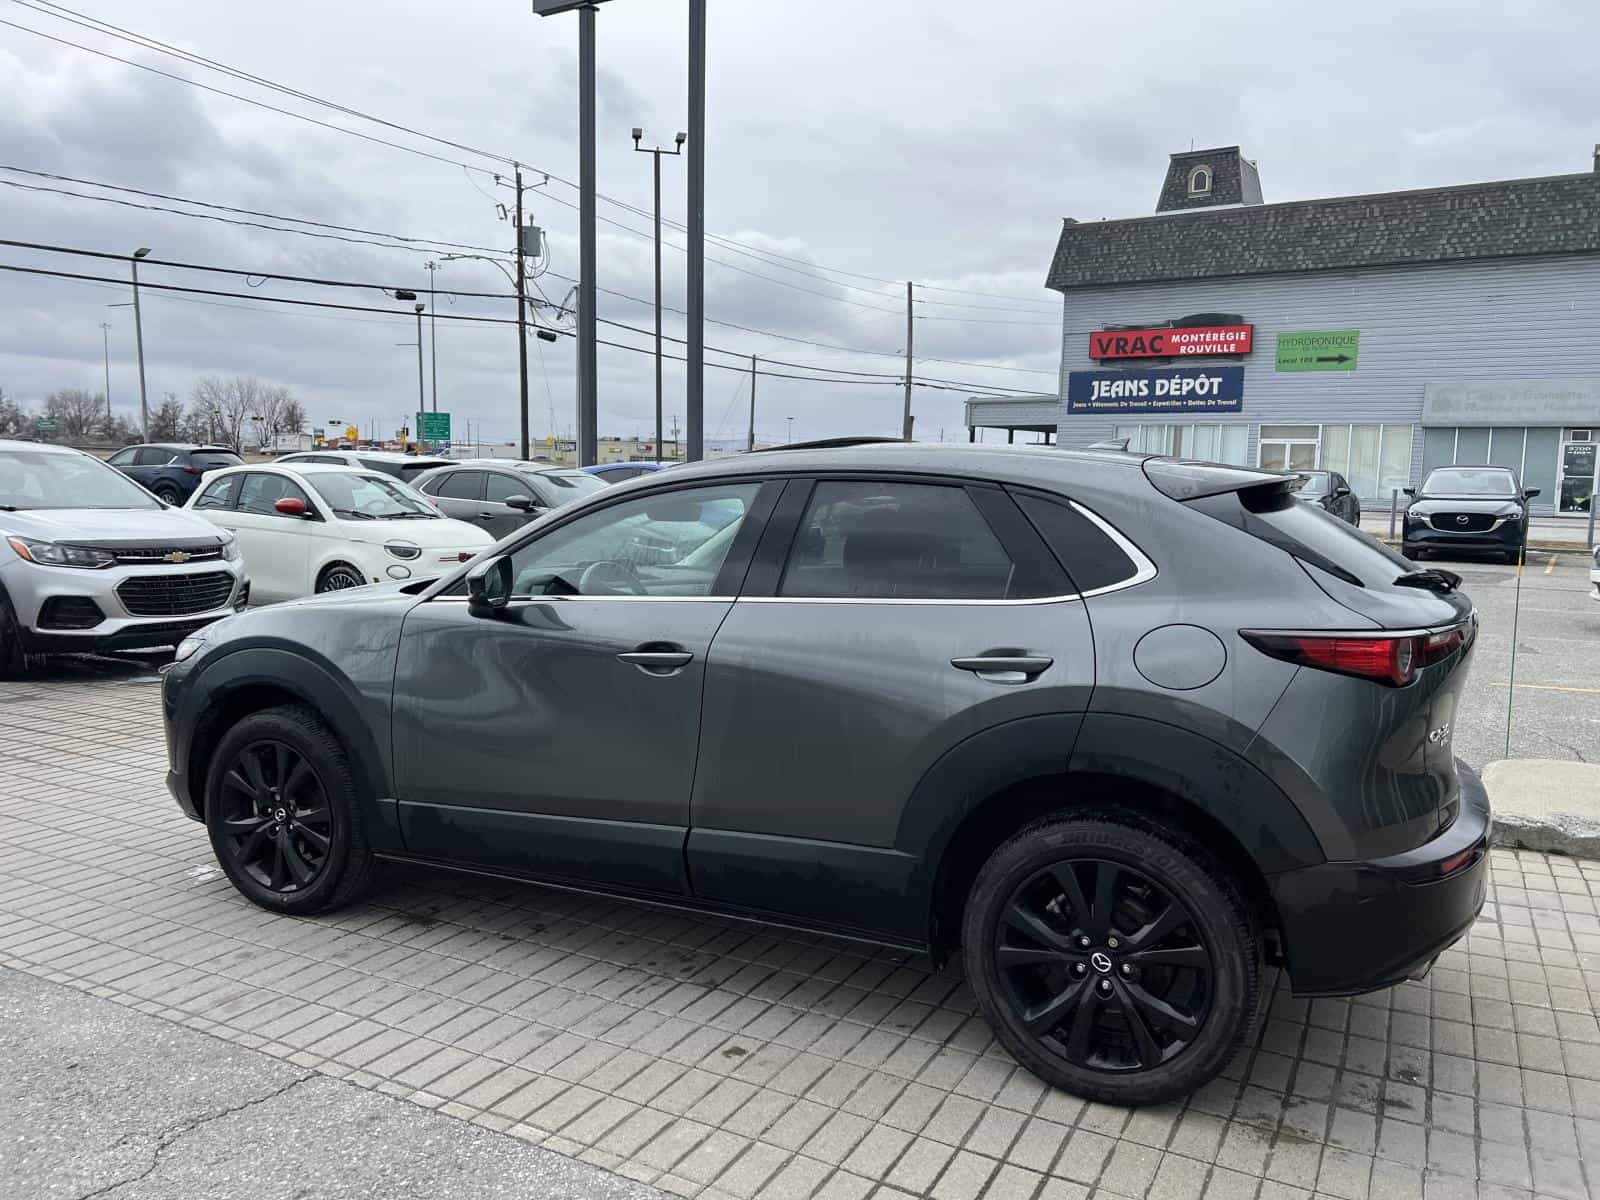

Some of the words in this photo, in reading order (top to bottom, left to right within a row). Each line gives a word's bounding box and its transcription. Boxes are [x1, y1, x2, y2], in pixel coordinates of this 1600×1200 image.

[1171, 330, 1247, 343] MONTÉRÉGIE
[1279, 335, 1357, 346] HYDROPONIQUE
[1097, 335, 1164, 355] VRAC
[1179, 344, 1236, 354] ROUVILLE
[1091, 380, 1149, 400] JEANS
[1155, 373, 1223, 396] DÉPÔT
